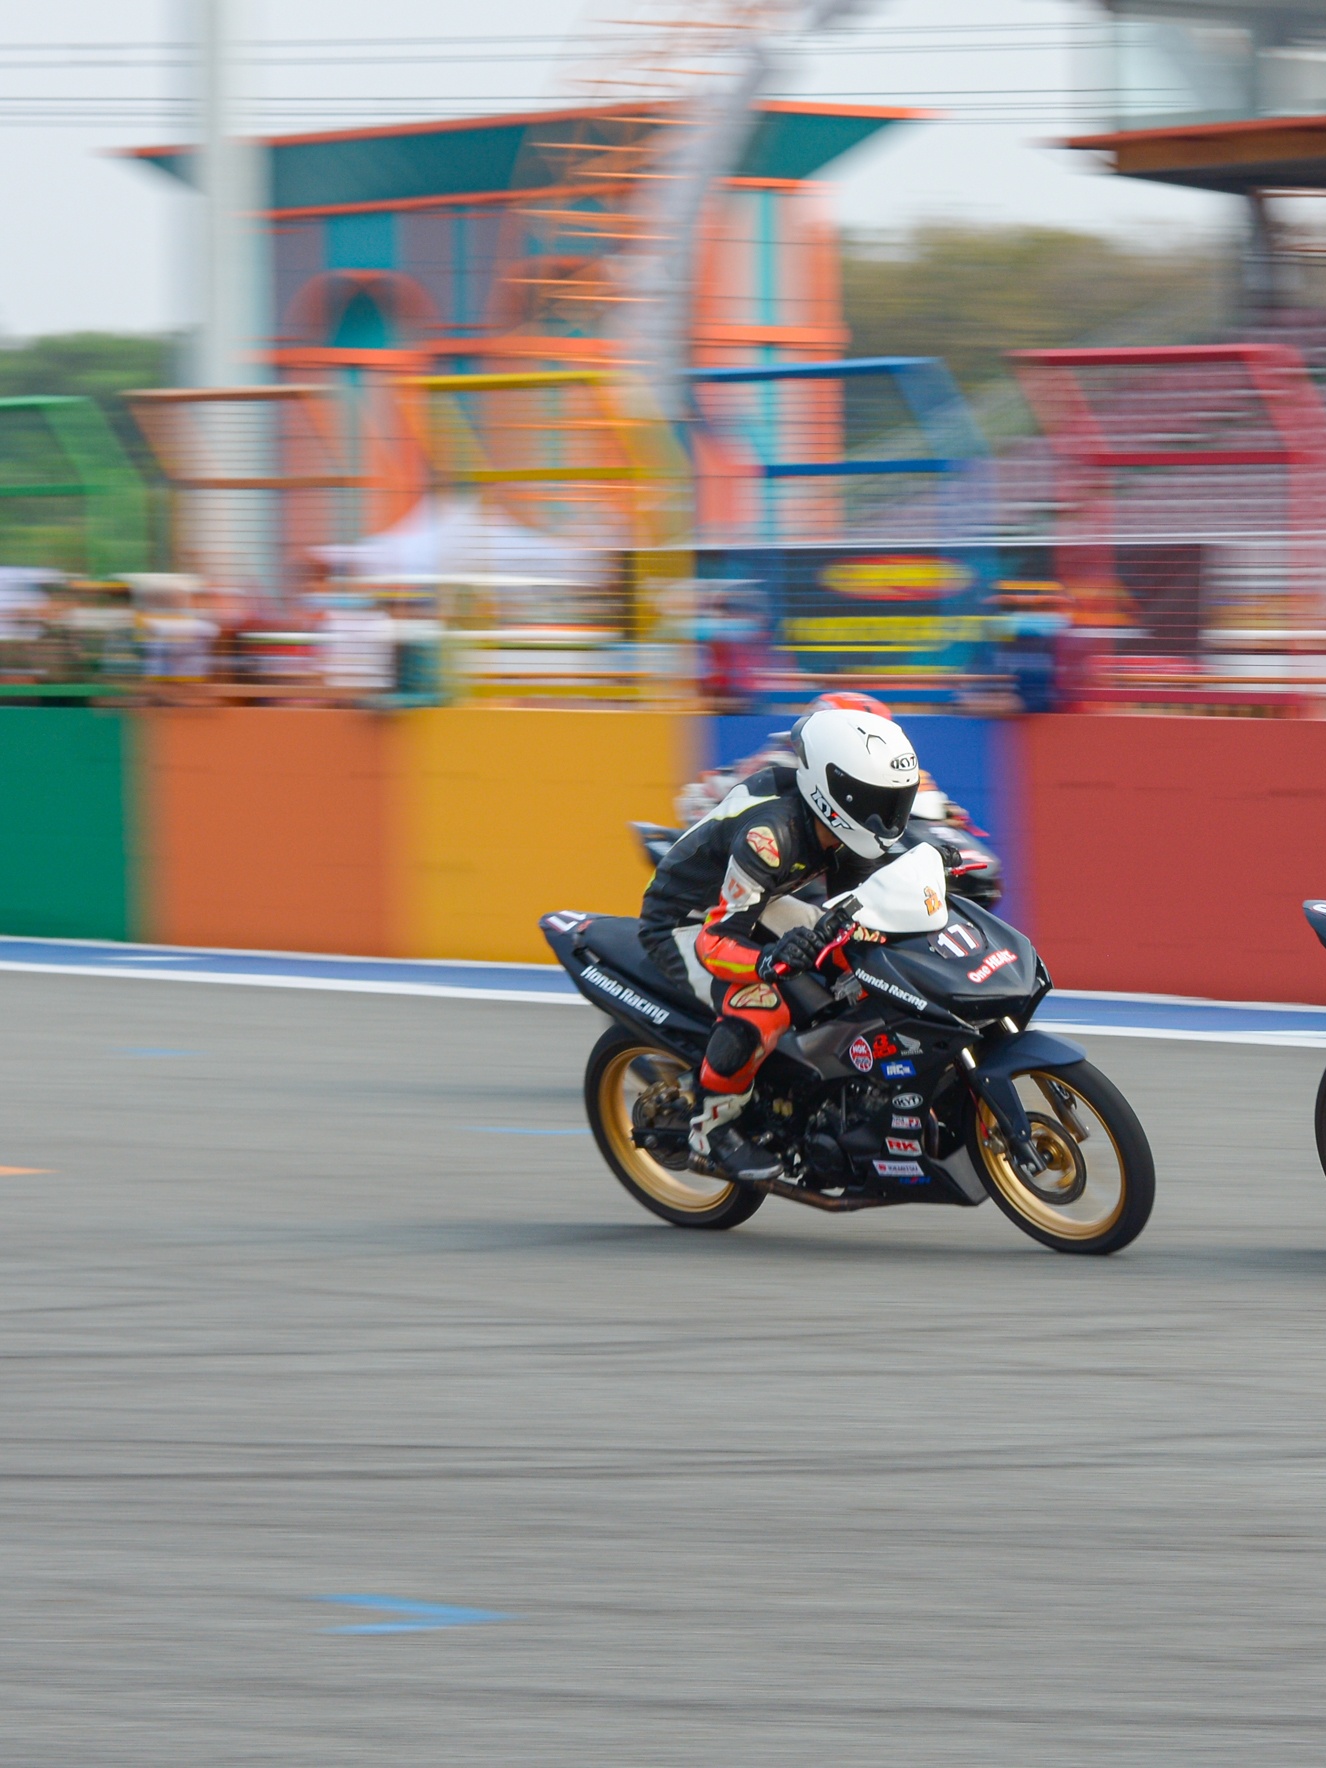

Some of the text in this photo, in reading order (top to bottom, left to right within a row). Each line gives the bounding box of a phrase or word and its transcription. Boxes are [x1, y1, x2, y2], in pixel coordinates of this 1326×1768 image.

[810, 784, 854, 831] KYT
[936, 923, 977, 958] 17
[580, 965, 670, 1025] Honda Racing
[855, 968, 928, 1011] Honda Racing
[887, 1139, 918, 1152] RK
